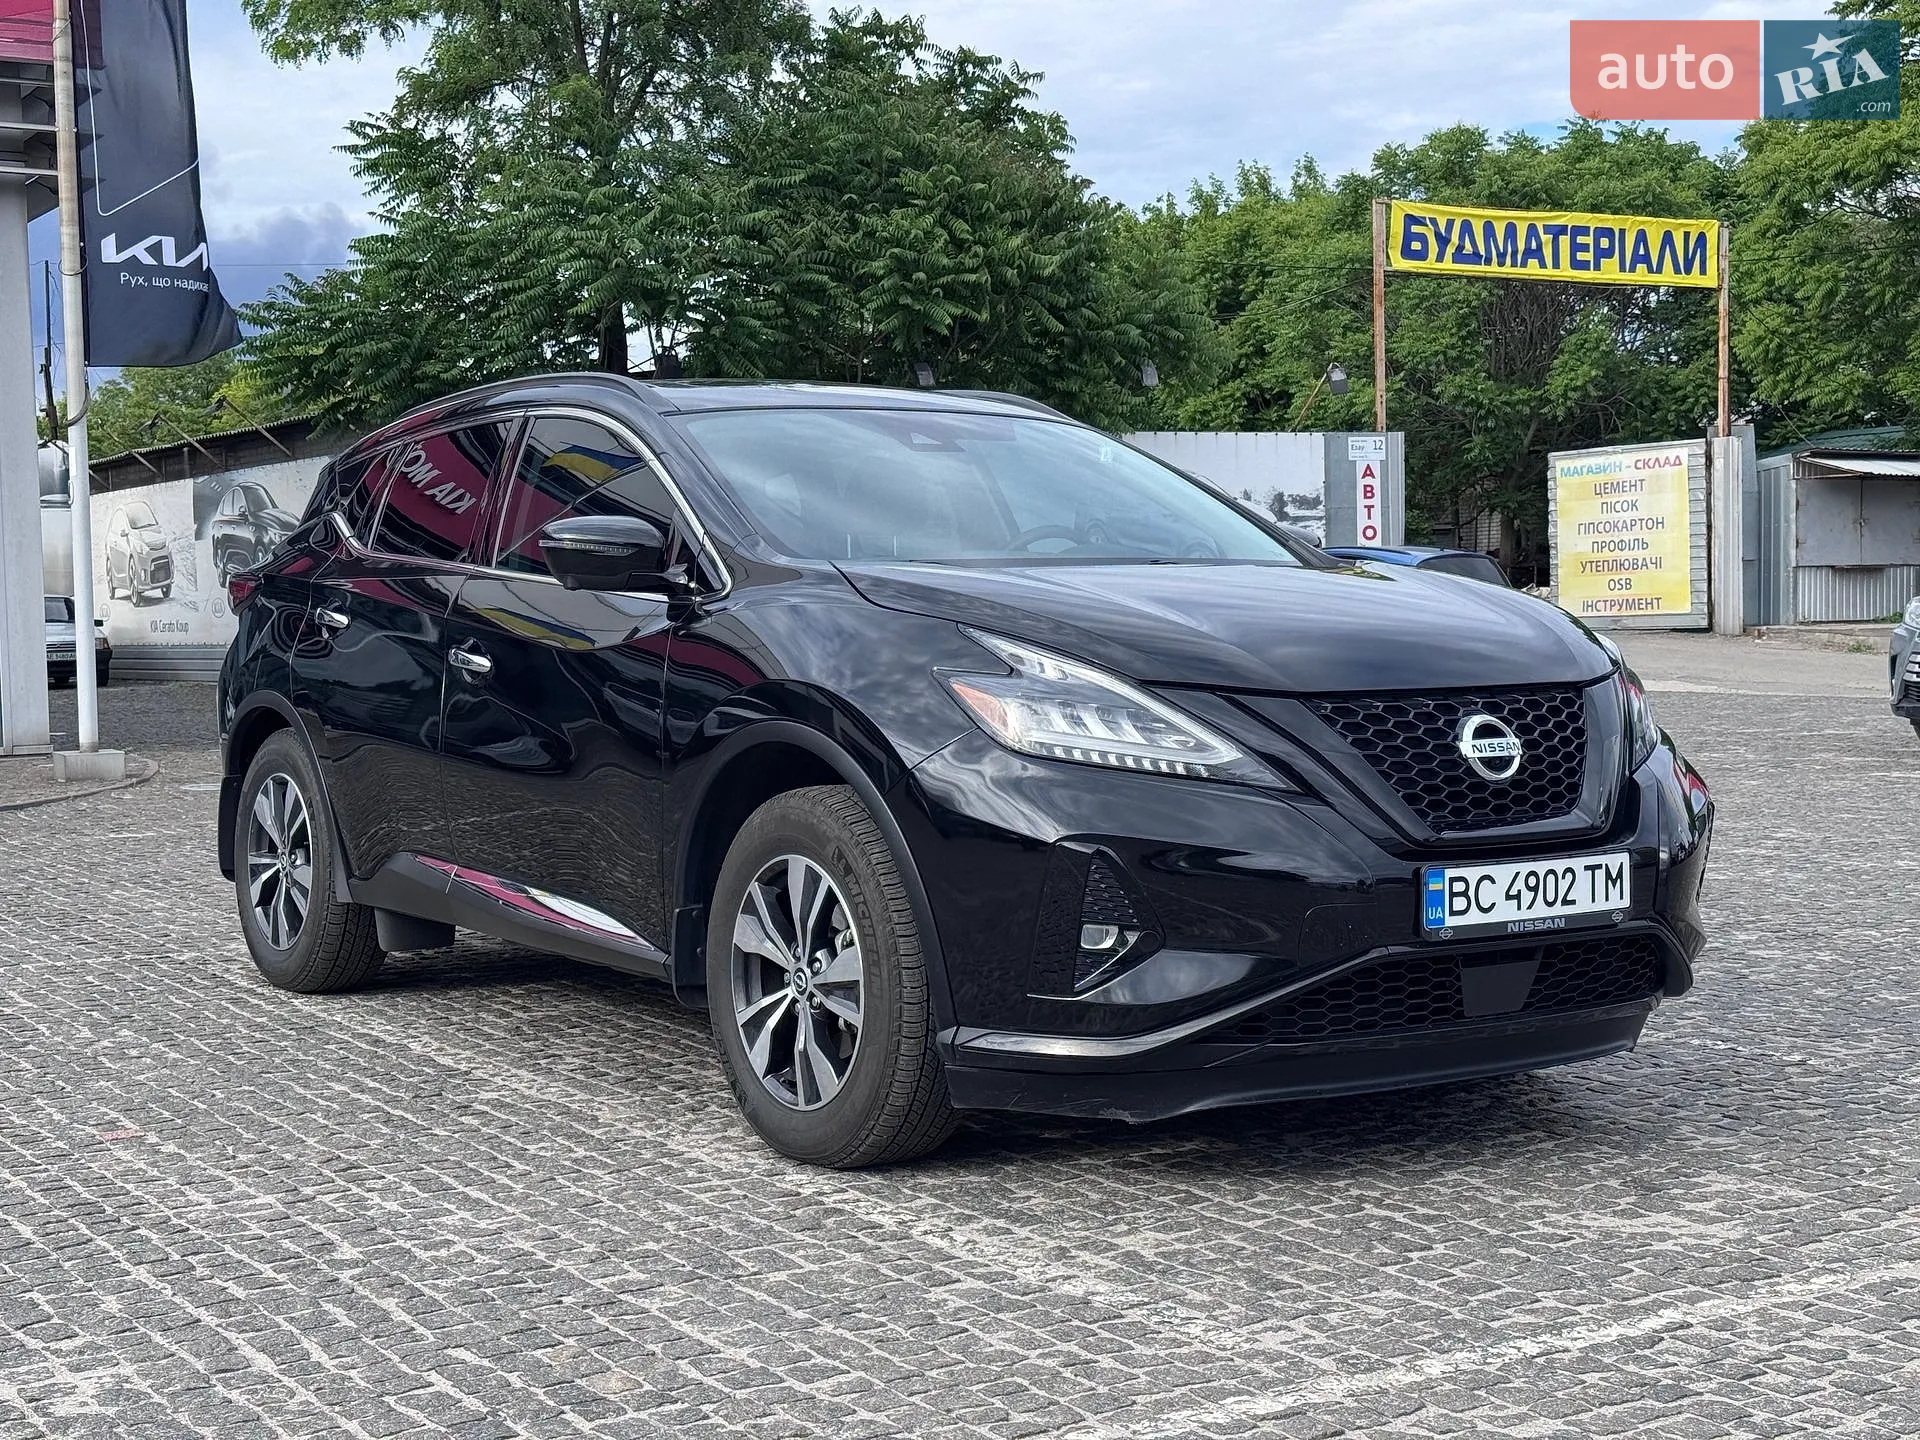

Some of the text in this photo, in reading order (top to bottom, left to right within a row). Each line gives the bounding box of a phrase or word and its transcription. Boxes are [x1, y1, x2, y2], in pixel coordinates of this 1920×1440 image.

[100, 233, 208, 271] KIA
[1400, 213, 1707, 276] БУДМАТЕРІАЛИ
[120, 272, 148, 287] Рух,
[152, 277, 171, 288] що
[1372, 440, 1384, 450] 12
[1560, 460, 1623, 478] МАГАЗИН
[1633, 454, 1683, 471] СКЛАД
[1593, 479, 1646, 498] ЦЕМЕНТ
[1361, 463, 1377, 541] АВТО
[1600, 499, 1639, 515] ПІСОК
[1577, 516, 1665, 536] ГІПСОКАРТОН
[1591, 537, 1649, 554] ПРОФІЛЬ
[1579, 557, 1662, 574] УТЕПЛЮВАЧІ
[1607, 578, 1632, 592] OSB
[1582, 597, 1662, 613] ІНСТРУМЕНТ
[150, 620, 159, 633] KIA
[159, 619, 175, 633] Cerato
[1472, 741, 1520, 754] NISSAN
[1449, 861, 1624, 917] BC 4902 TM
[1428, 906, 1444, 919] UA
[1507, 918, 1566, 933] NISSAN
